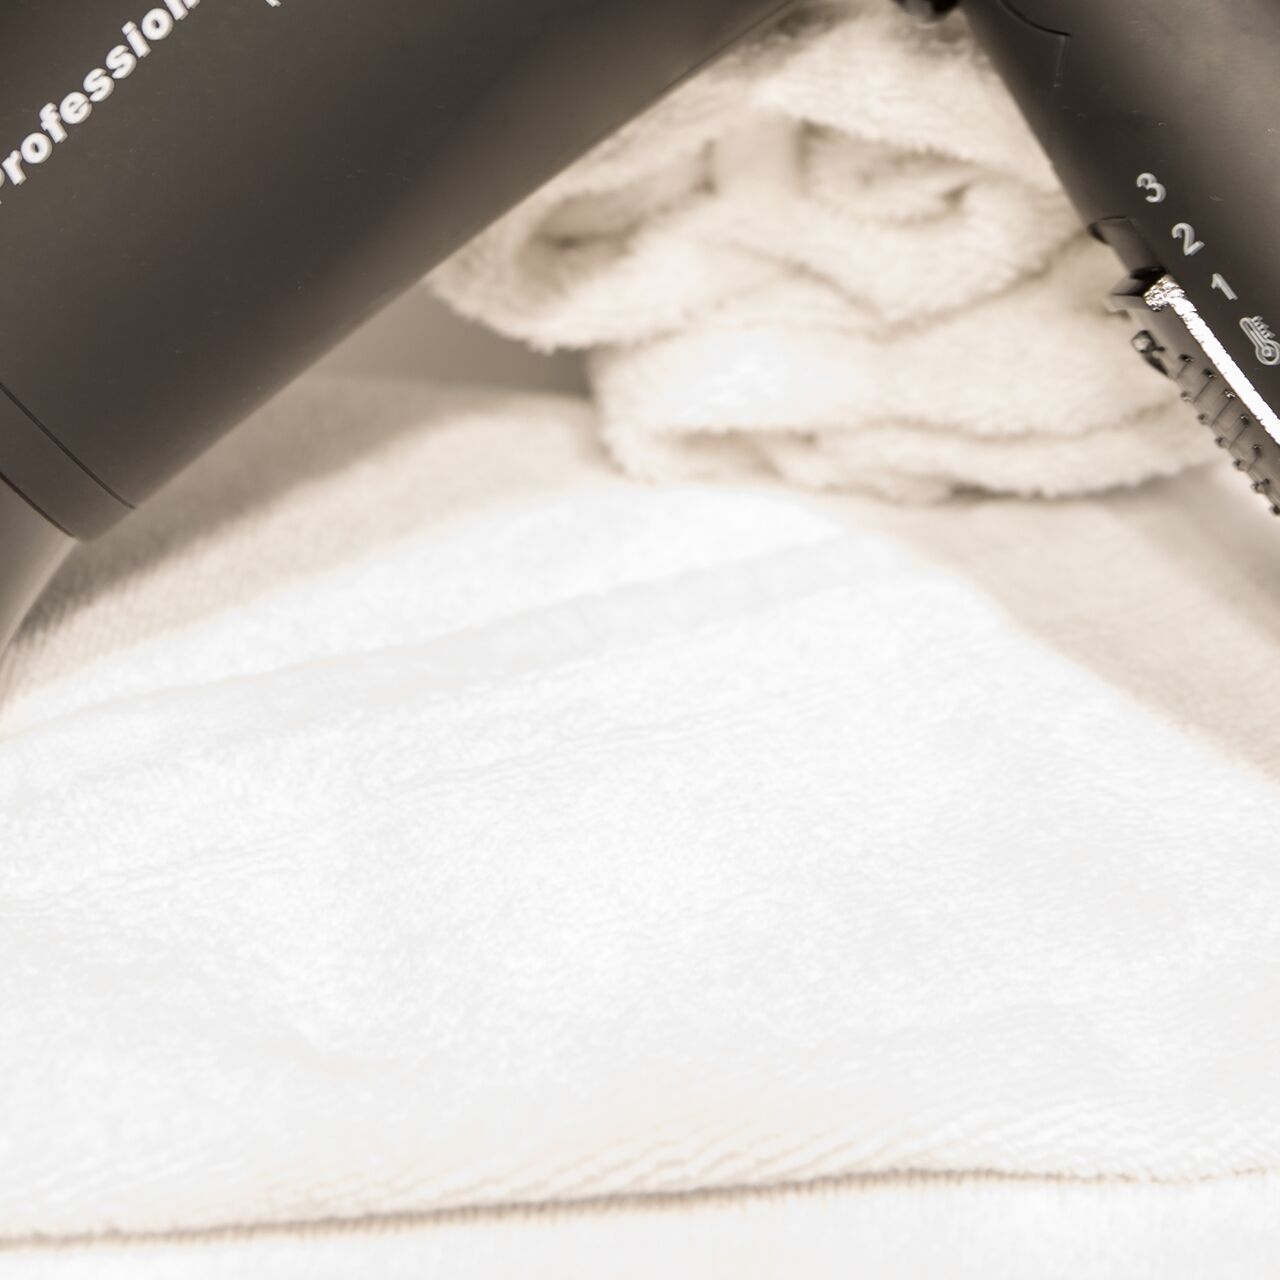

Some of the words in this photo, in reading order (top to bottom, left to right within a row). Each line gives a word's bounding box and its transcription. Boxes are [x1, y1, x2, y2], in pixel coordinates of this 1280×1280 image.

[1136, 172, 1166, 204] 3
[1171, 222, 1205, 256] 2
[1211, 272, 1238, 301] 1
